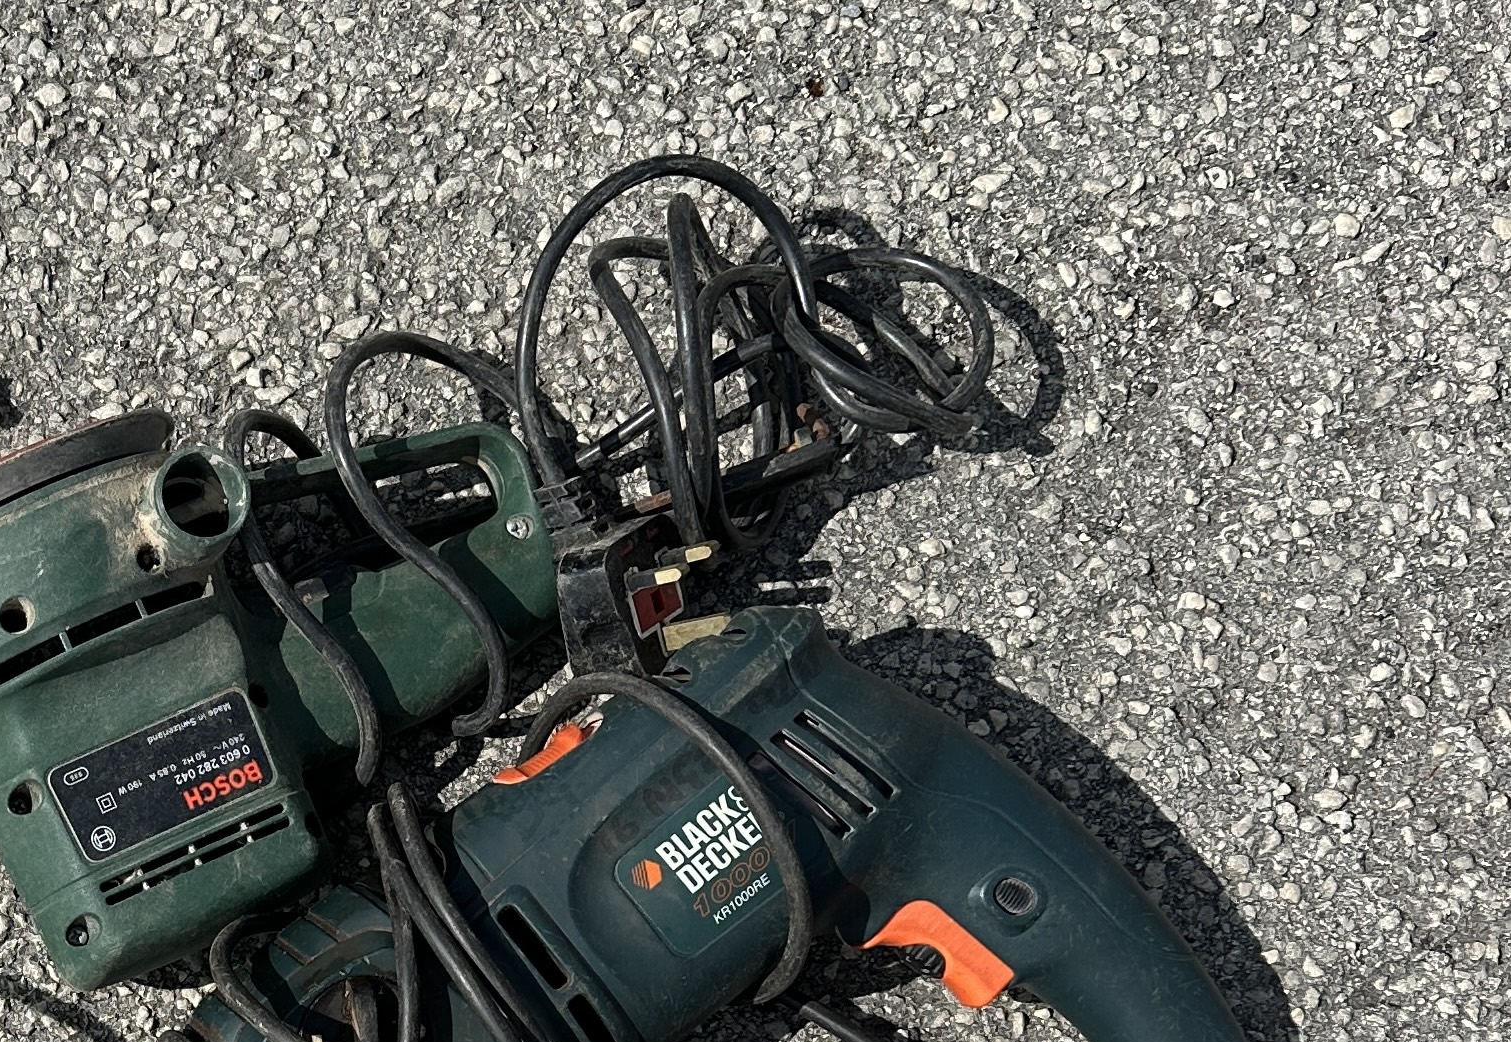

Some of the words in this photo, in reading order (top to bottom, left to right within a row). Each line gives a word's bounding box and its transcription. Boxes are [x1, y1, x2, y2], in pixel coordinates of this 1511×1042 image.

[146, 717, 198, 745] Switzerland
[219, 750, 241, 765] 603
[242, 744, 251, 755] 0
[174, 768, 196, 785] 042
[196, 758, 220, 775] 282
[182, 758, 264, 811] BOSCH
[676, 811, 763, 894] DECKE
[693, 846, 771, 918] 1000
[713, 872, 771, 925] KR1000RE
